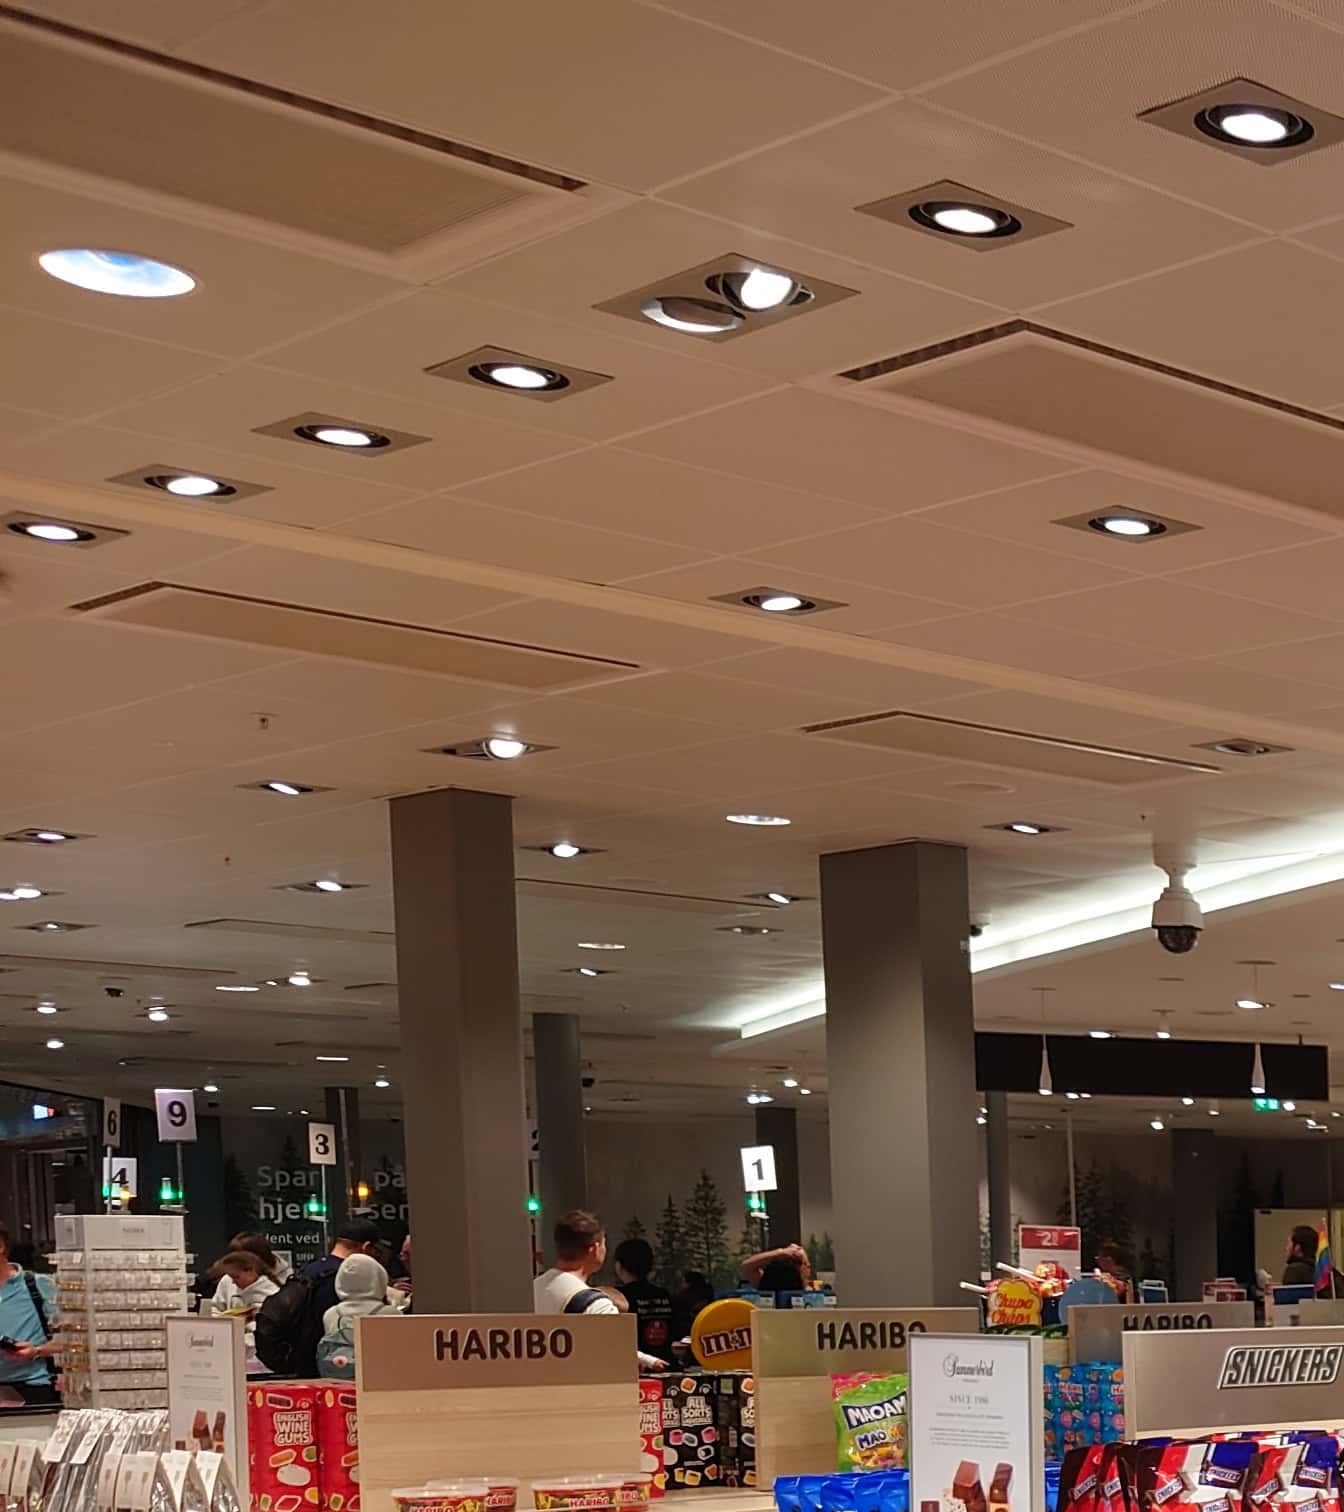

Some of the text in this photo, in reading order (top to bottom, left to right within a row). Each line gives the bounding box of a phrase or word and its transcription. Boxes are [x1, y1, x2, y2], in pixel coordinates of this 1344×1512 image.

[107, 1110, 116, 1135] 6
[169, 1101, 187, 1126] 9
[315, 1133, 329, 1155] 3
[753, 1158, 764, 1180] 1
[995, 1293, 1033, 1312] Chupa
[435, 1328, 573, 1361] HARIBO
[943, 1353, 994, 1378] Summerbird
[1222, 1345, 1343, 1385] SNICKERS
[276, 1412, 311, 1422] ENGLISH
[682, 1407, 712, 1419] SORTS
[275, 1432, 312, 1444] GUMS
[277, 1421, 310, 1434] WINE
[569, 1496, 609, 1508] HARIBO
